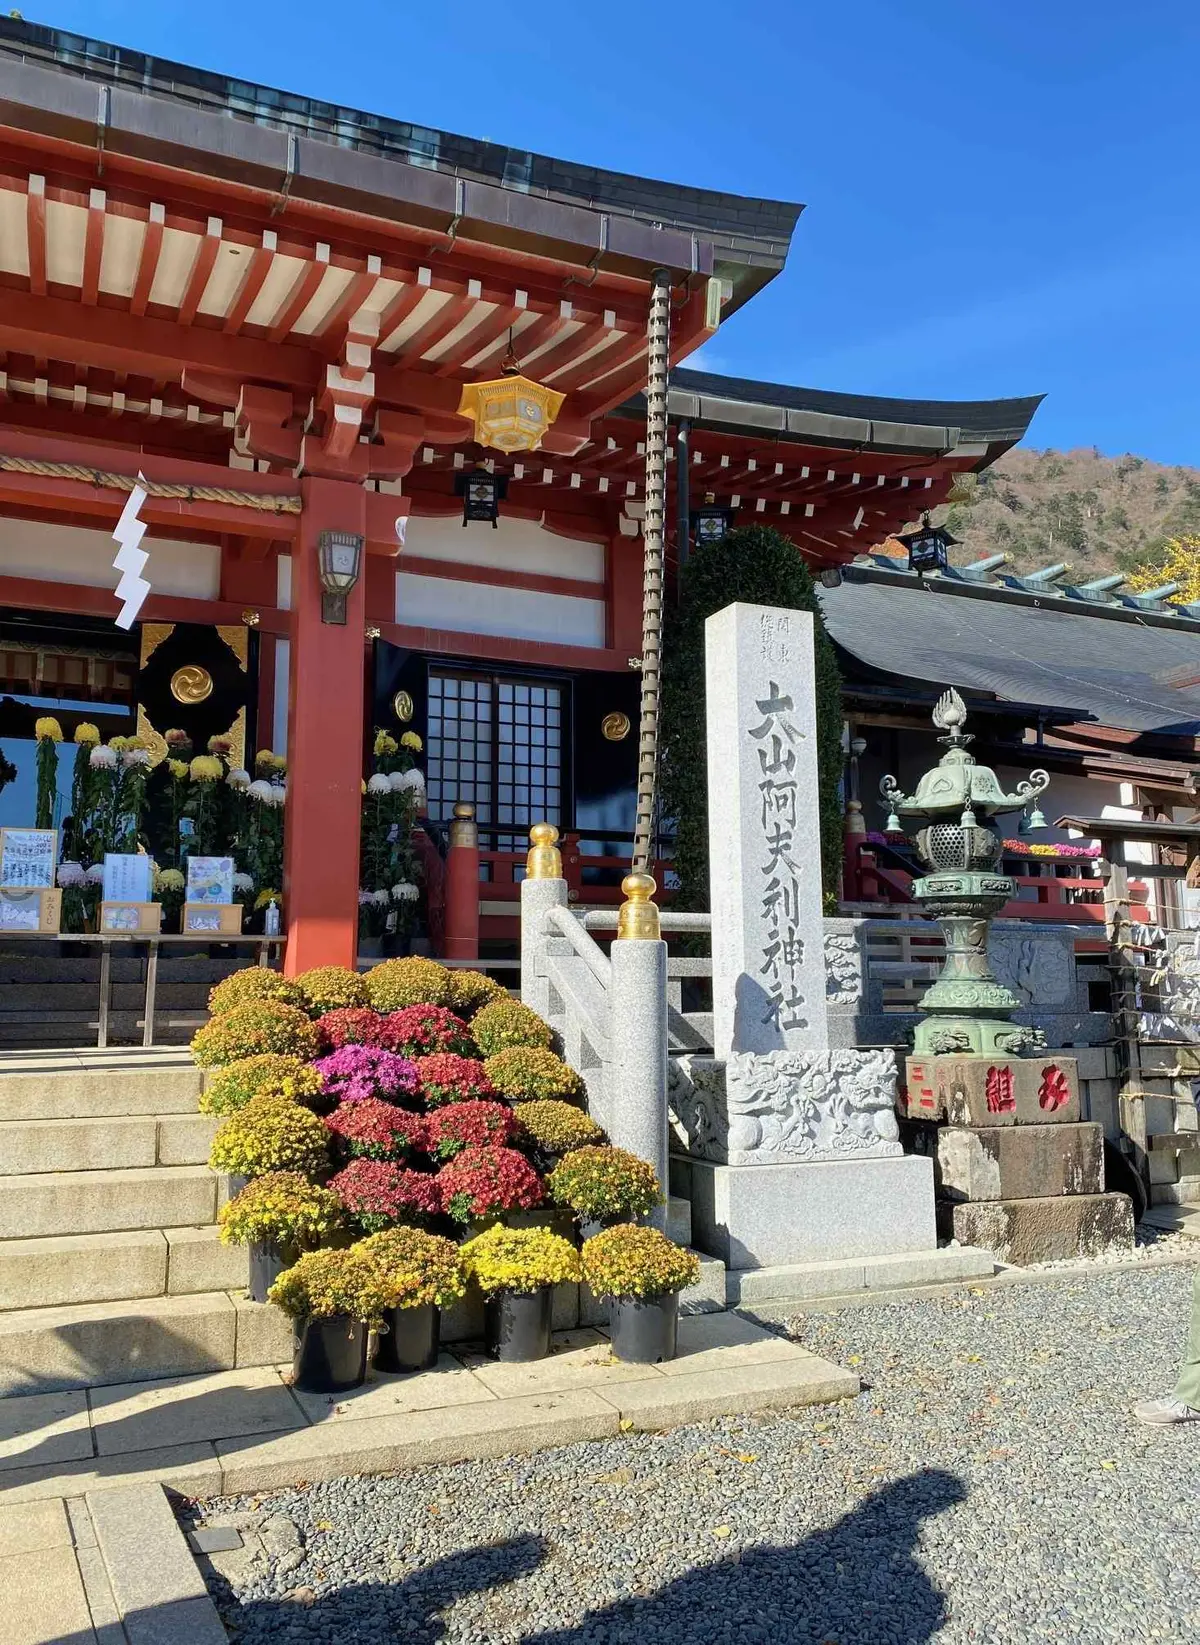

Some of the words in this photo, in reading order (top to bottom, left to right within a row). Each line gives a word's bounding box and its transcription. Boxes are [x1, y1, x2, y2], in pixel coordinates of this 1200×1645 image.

[46, 896, 55, 925] おみくじ
[748, 680, 809, 1032] 大山阿夫利神社
